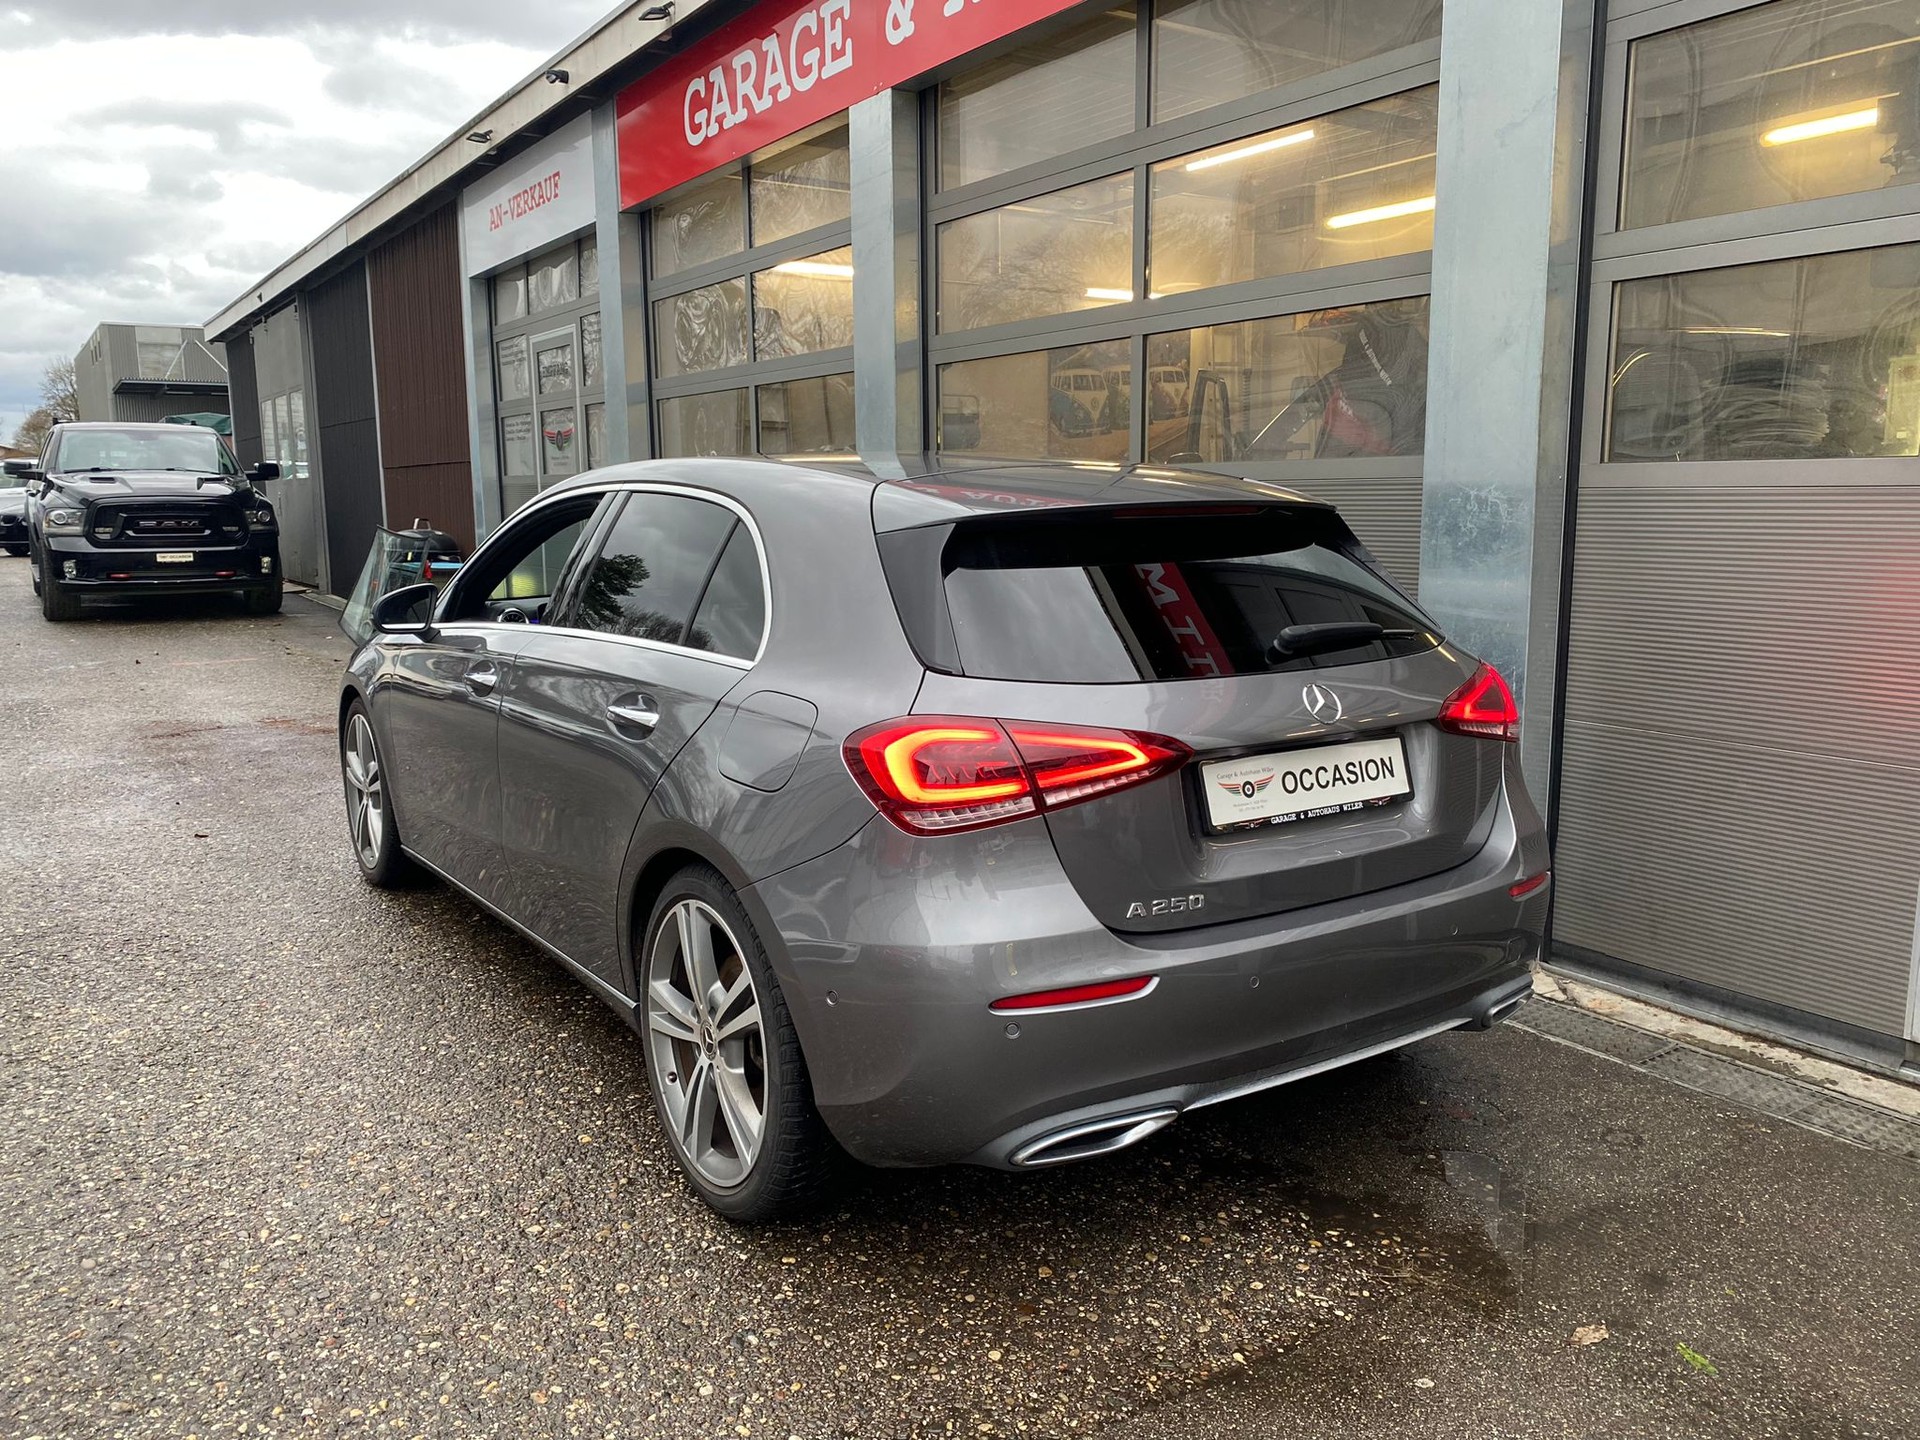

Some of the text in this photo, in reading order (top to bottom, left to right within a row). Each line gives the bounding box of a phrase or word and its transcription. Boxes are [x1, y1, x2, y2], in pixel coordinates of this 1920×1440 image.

[683, 0, 915, 147] GARAGE &
[489, 171, 561, 232] AN-VERKAUF
[1281, 756, 1395, 795] OCCASION
[1270, 801, 1364, 825] GARAGE & AUTOHAUS WILER
[1126, 893, 1205, 918] A 250
